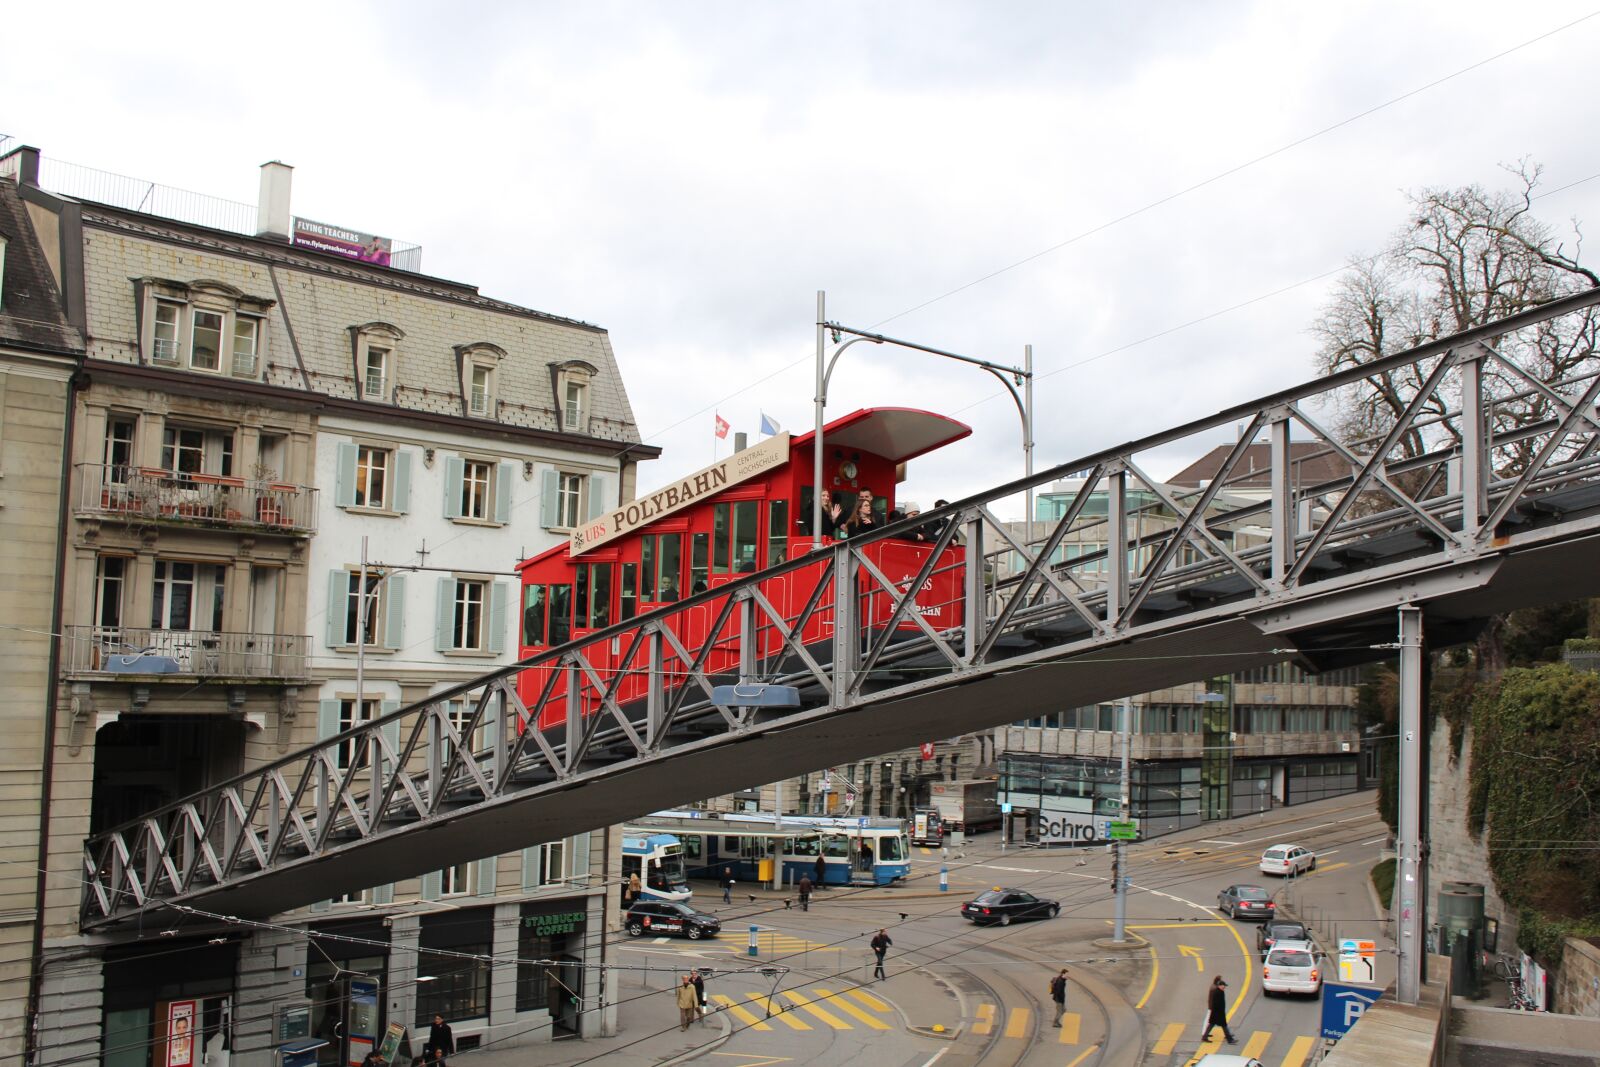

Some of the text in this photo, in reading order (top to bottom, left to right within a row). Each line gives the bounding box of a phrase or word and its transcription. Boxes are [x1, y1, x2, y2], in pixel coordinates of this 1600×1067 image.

[297, 221, 359, 243] FLYING TEACHERS
[296, 237, 358, 256] www.flyingteachers.com
[737, 449, 767, 466] CENTRAL-
[738, 452, 779, 476] HOCHSCHULE
[584, 464, 727, 543] UBS POLYBAHN
[525, 912, 585, 928] STARBUCKS
[536, 923, 574, 936] COFFEE
[1344, 1000, 1365, 1026] P
